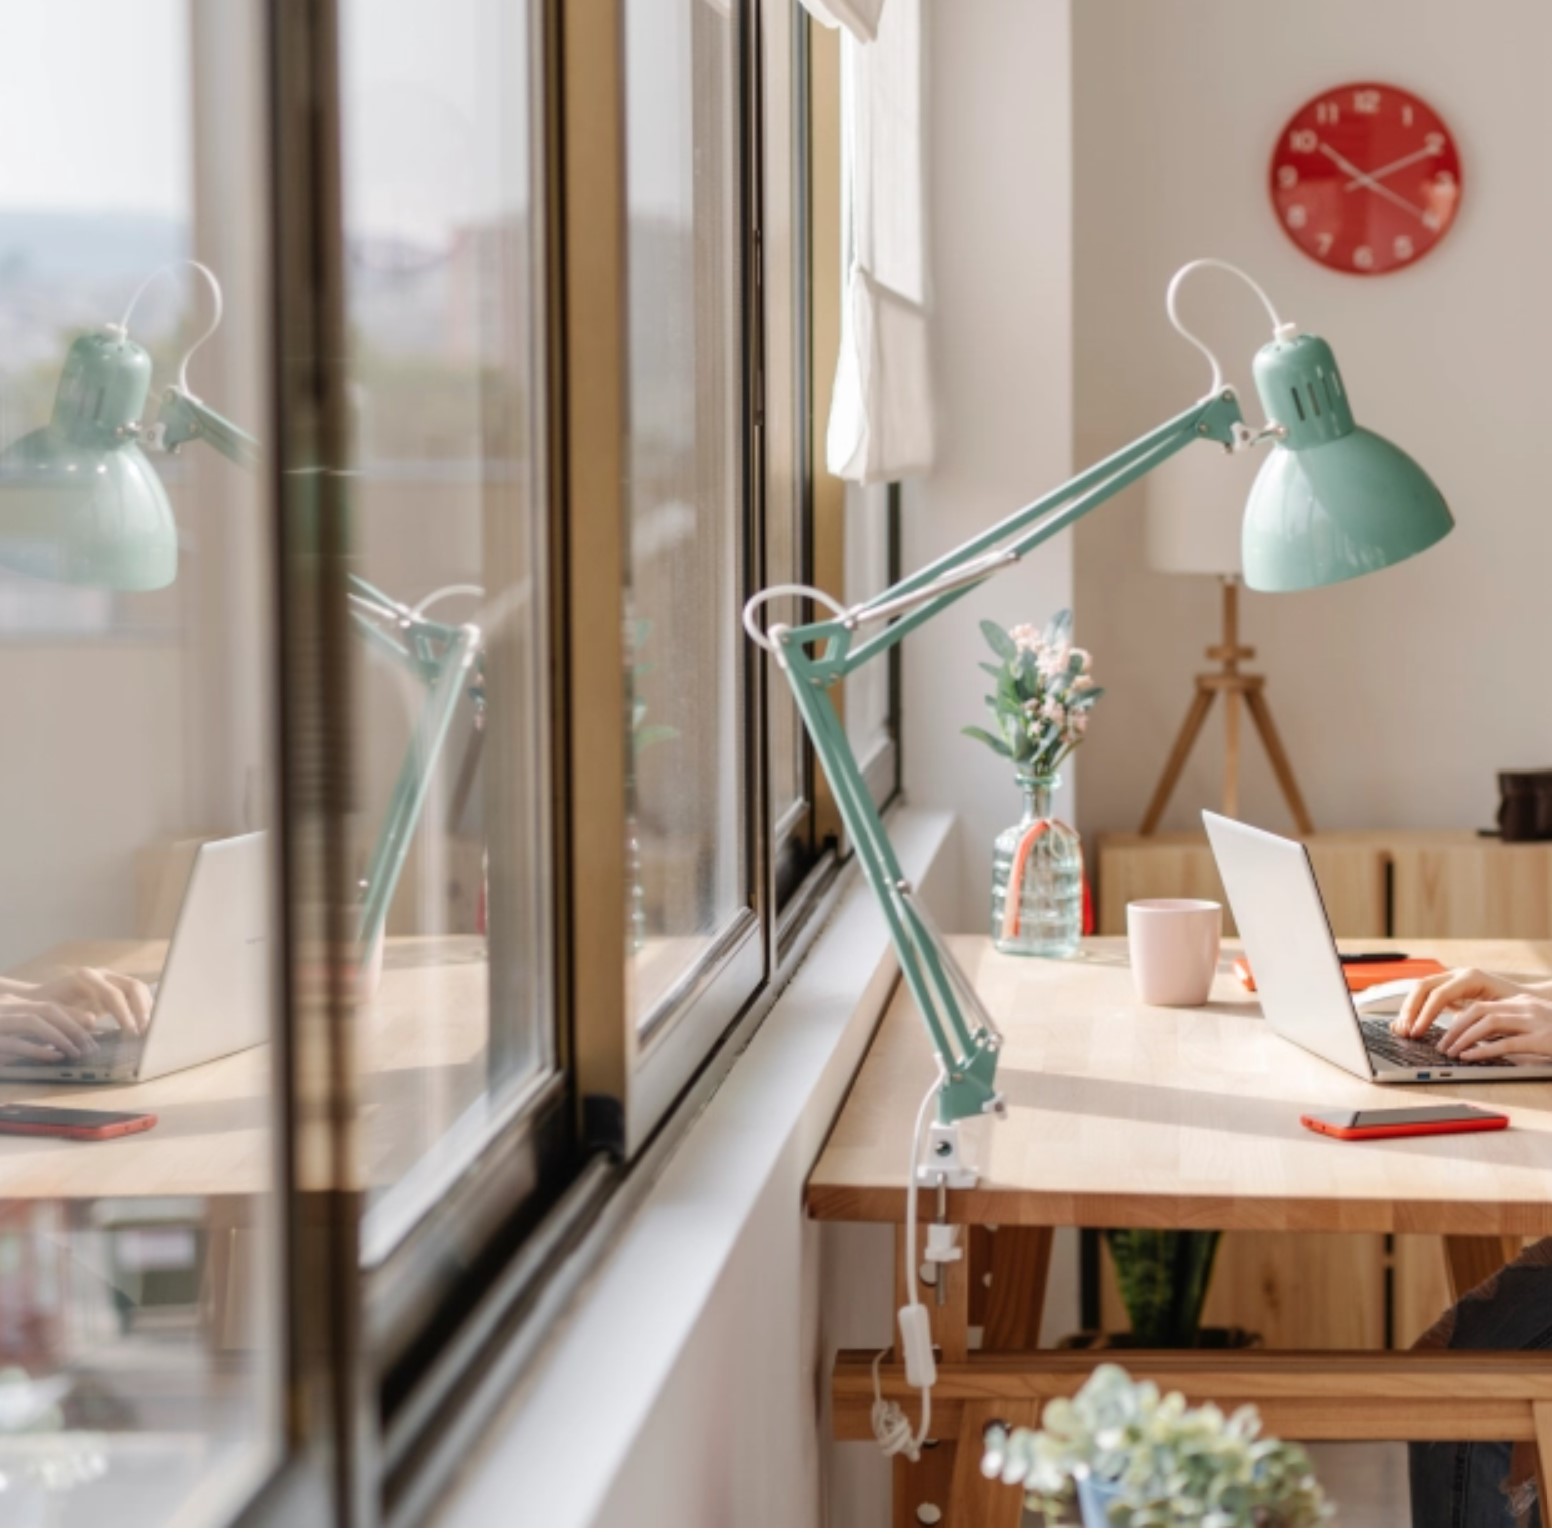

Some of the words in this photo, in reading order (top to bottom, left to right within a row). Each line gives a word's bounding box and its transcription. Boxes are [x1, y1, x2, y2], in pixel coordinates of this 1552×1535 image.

[1316, 102, 1339, 125] 11
[1353, 90, 1380, 114] 12
[1402, 104, 1413, 127] 1
[1290, 129, 1318, 154] 10
[1424, 131, 1445, 156] 2
[1278, 165, 1298, 189] 9
[1435, 170, 1455, 195] 3
[1287, 204, 1307, 229] 8
[1316, 232, 1334, 256] 7
[1353, 244, 1374, 269] 6
[1393, 235, 1413, 260] 5
